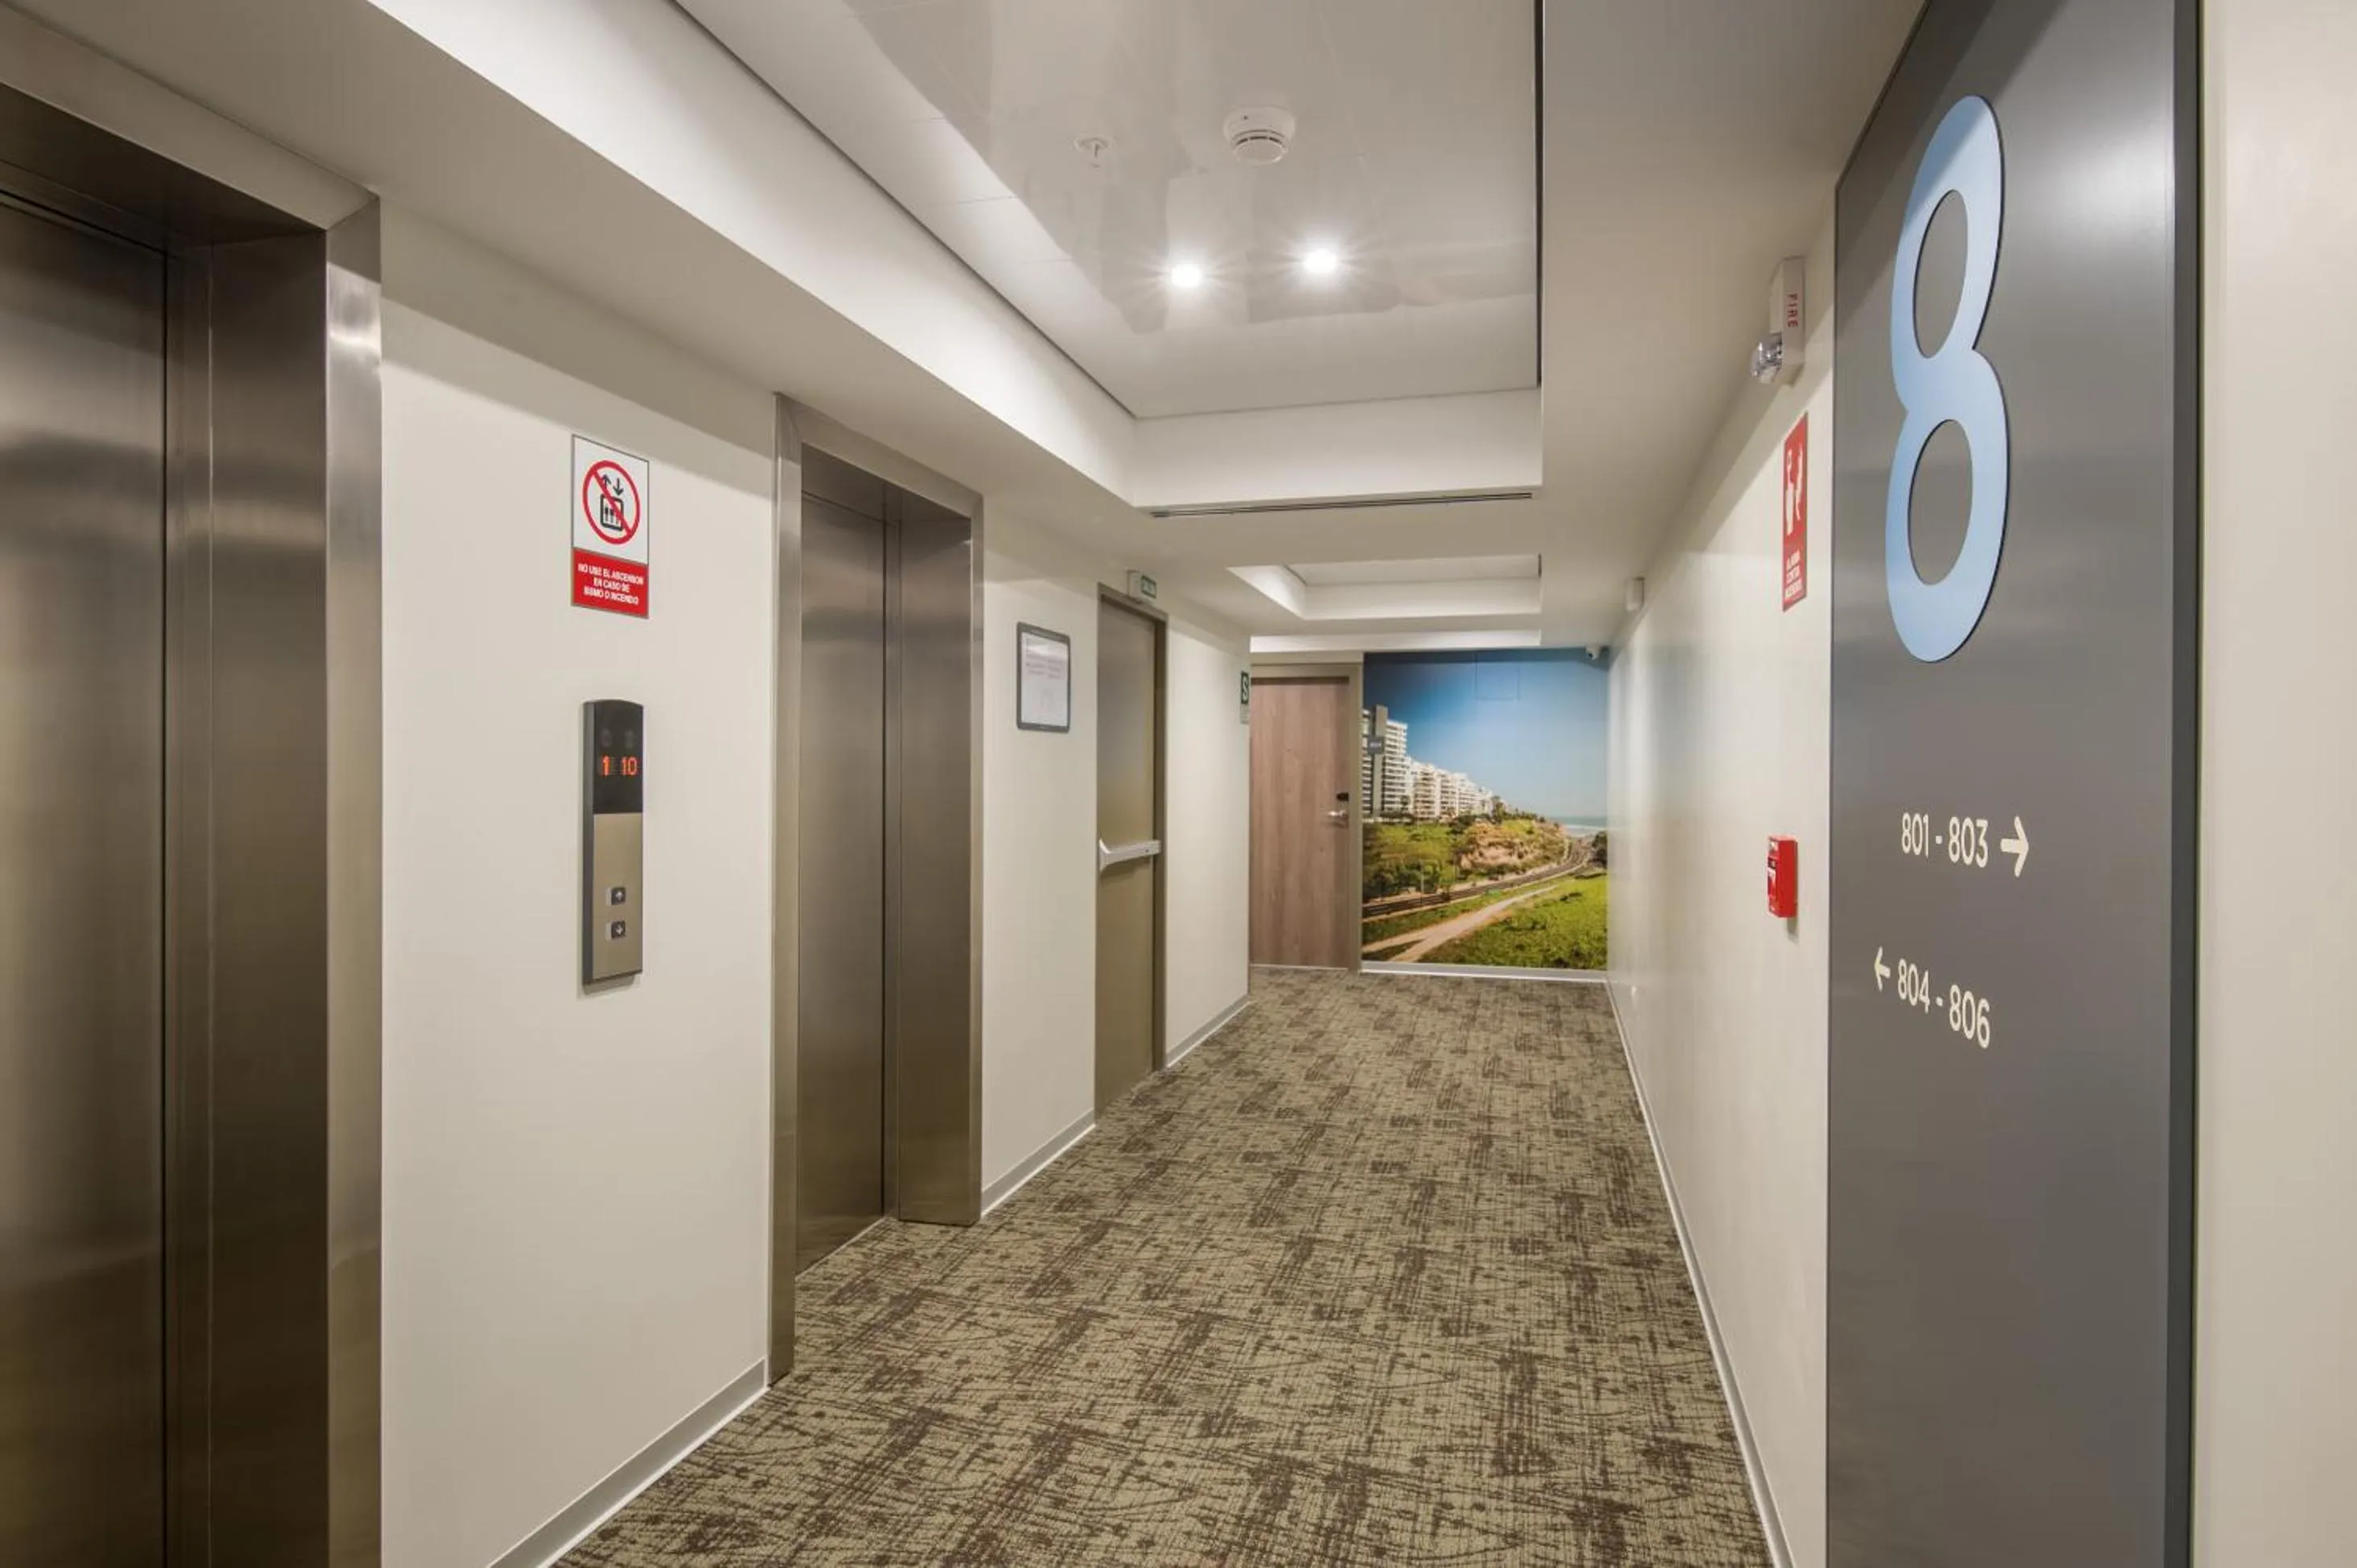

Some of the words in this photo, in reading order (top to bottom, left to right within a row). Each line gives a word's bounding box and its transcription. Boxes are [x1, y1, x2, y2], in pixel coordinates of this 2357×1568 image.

[1787, 293, 1799, 328] FIRE
[1886, 95, 2009, 663] 8
[577, 563, 588, 573] NO
[602, 755, 610, 776] 1
[622, 756, 638, 776] 10
[1902, 812, 1929, 859] 801
[1948, 816, 1989, 868] 803
[1898, 958, 1930, 1014] 804
[1949, 984, 1990, 1049] 806
